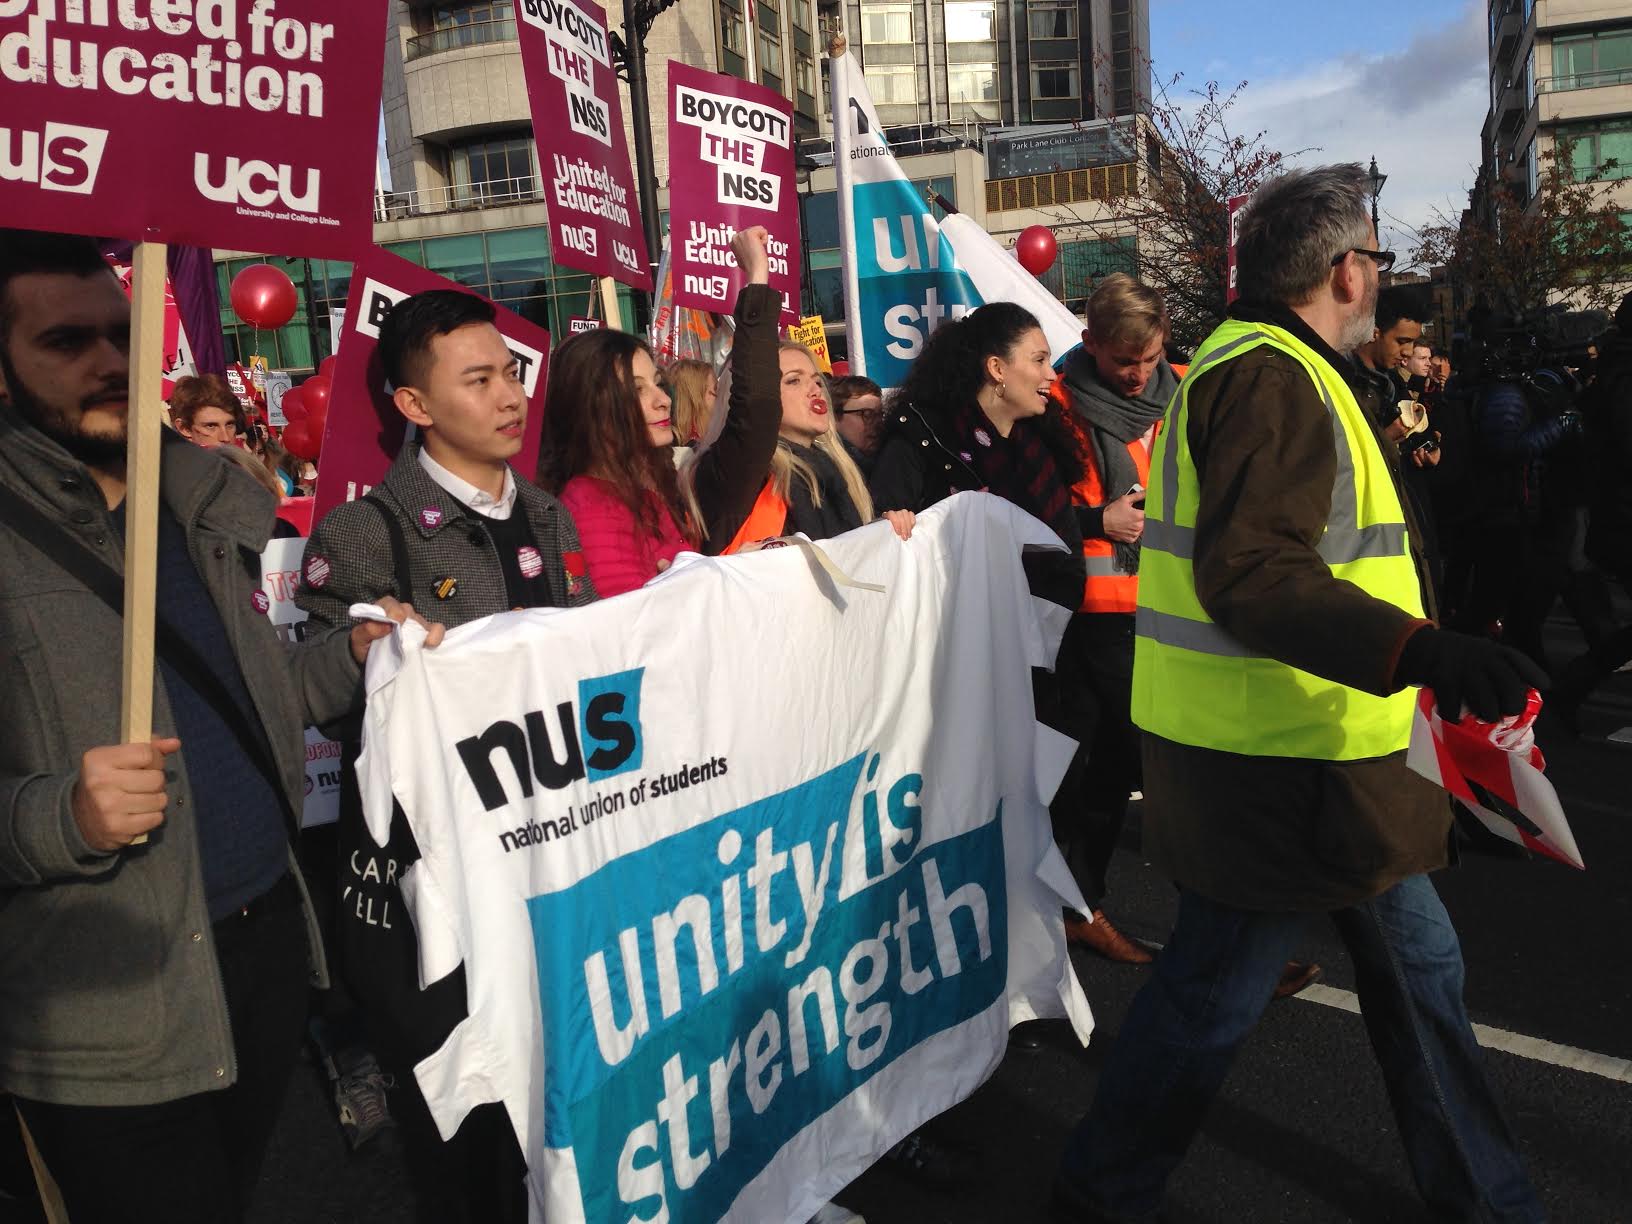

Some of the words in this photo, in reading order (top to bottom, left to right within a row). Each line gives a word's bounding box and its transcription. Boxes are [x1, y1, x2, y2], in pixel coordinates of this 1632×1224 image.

[248, 0, 334, 62] for
[524, 0, 605, 57] BOYCOTT
[0, 14, 324, 117] ducation
[549, 39, 590, 87] THE
[570, 92, 607, 137] NSS
[681, 92, 787, 140] BOYCOTT
[0, 121, 109, 194] us
[705, 133, 755, 167] THE
[850, 144, 890, 160] ational
[1011, 142, 1028, 151] Park
[1029, 140, 1049, 149] Lane
[1049, 137, 1067, 145] Club
[553, 153, 611, 193] United
[610, 175, 627, 205] for
[723, 172, 773, 204] NSS
[236, 206, 275, 219] University
[290, 213, 319, 224] College
[319, 216, 340, 226] Union
[553, 177, 631, 228] Education
[561, 223, 597, 257] nus
[684, 239, 789, 276] Educon
[690, 220, 737, 247] Unit
[766, 234, 789, 258] for
[685, 274, 729, 301] nus
[572, 321, 597, 330] FUND
[794, 328, 811, 340] Fight
[811, 324, 821, 335] for
[801, 335, 825, 347] cation
[456, 691, 637, 812] nus
[498, 814, 579, 852] national
[579, 790, 626, 826] union
[629, 777, 647, 806] of
[650, 754, 729, 799] students
[583, 820, 839, 1068] unity
[862, 751, 924, 882] is
[616, 857, 994, 1224] strength
